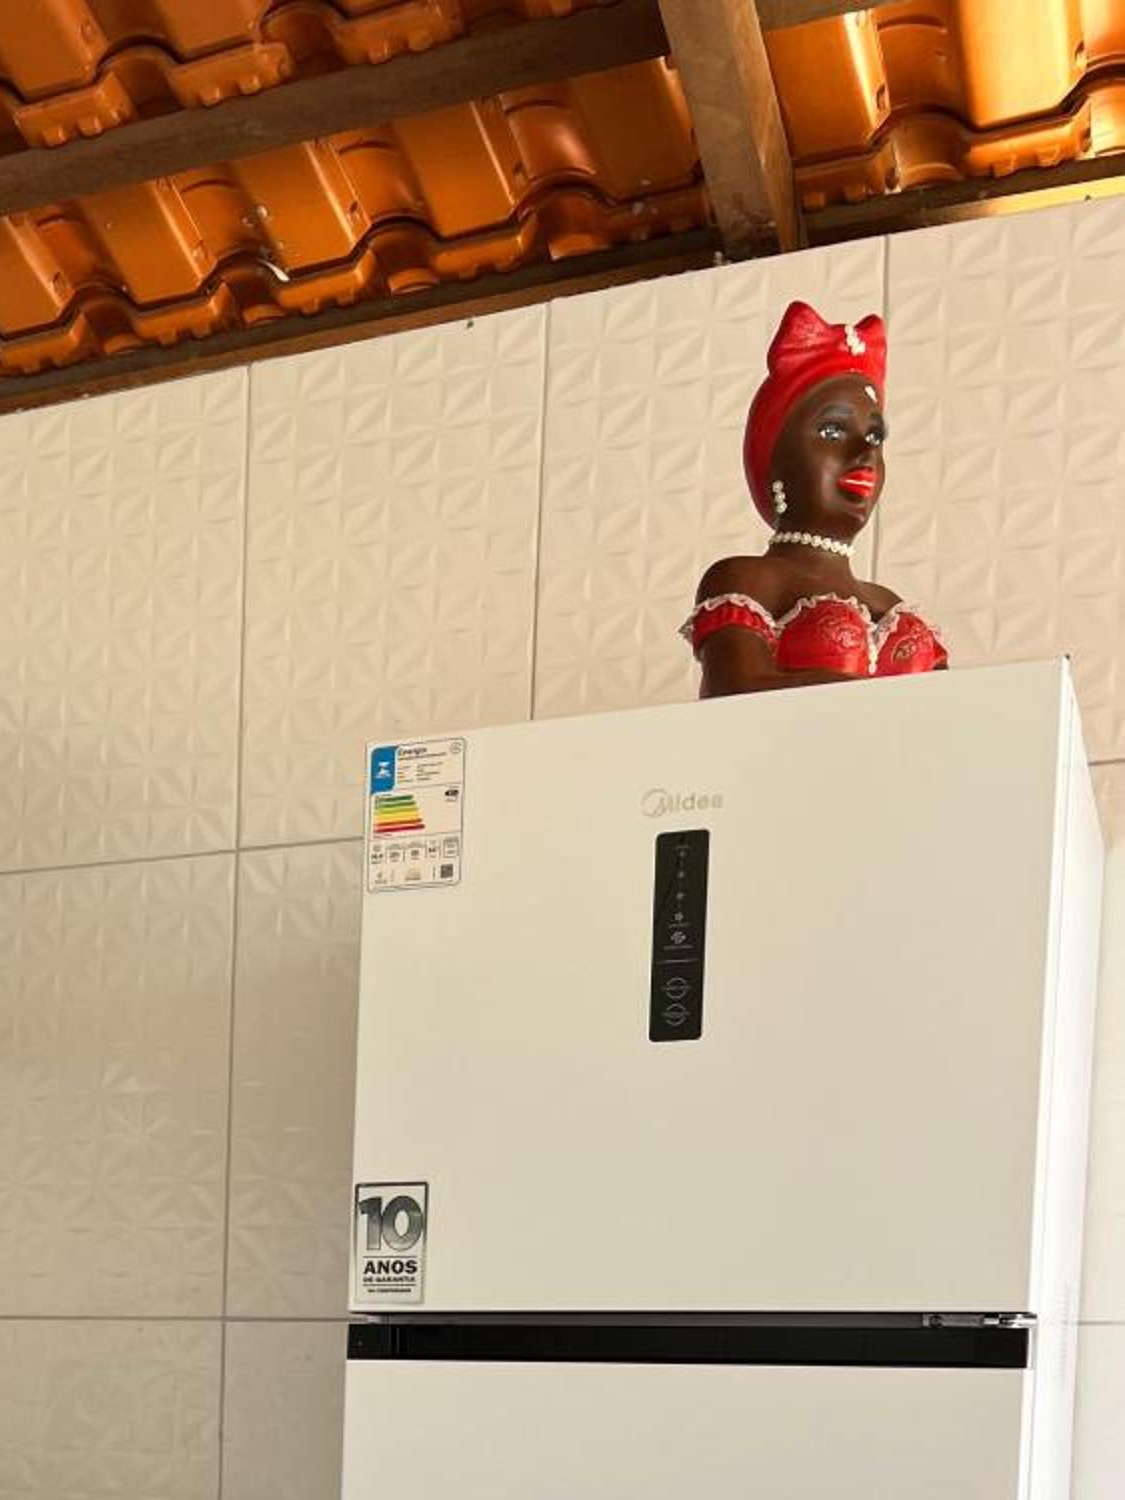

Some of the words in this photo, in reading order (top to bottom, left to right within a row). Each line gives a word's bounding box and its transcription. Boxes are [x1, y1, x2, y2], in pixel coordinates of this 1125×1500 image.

[642, 788, 723, 818] Midea
[358, 1195, 423, 1251] 10
[364, 1260, 417, 1275] ANOS
